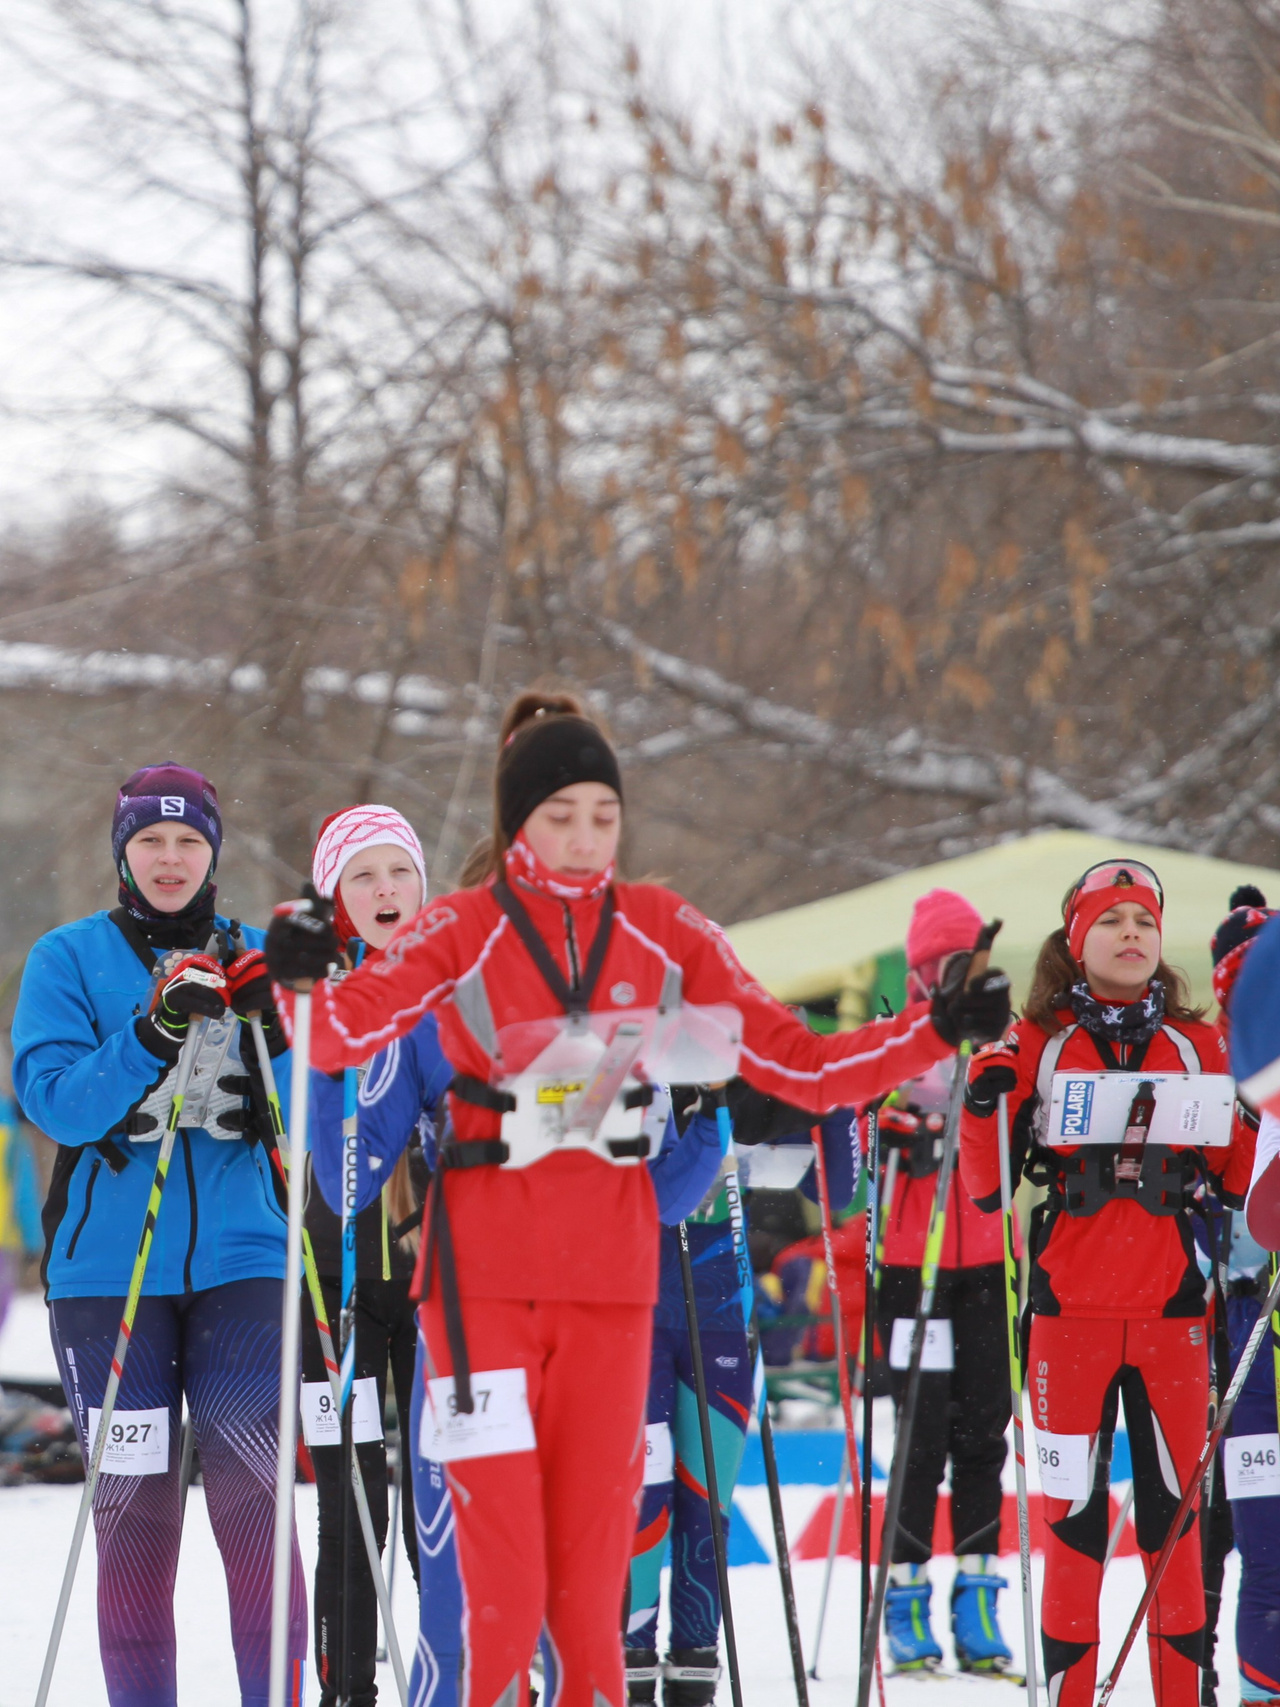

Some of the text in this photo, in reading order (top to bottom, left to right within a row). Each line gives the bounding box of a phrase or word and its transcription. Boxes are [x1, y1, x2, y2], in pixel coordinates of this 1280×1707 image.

[1064, 1081, 1087, 1136] POLARIS
[725, 1173, 751, 1289] salomon
[319, 1393, 358, 1414] 97
[447, 1388, 492, 1417] 97
[315, 1414, 333, 1423] Ж14
[111, 1423, 152, 1443] 927
[105, 1443, 125, 1453] Ж14
[1241, 1448, 1277, 1468] 946
